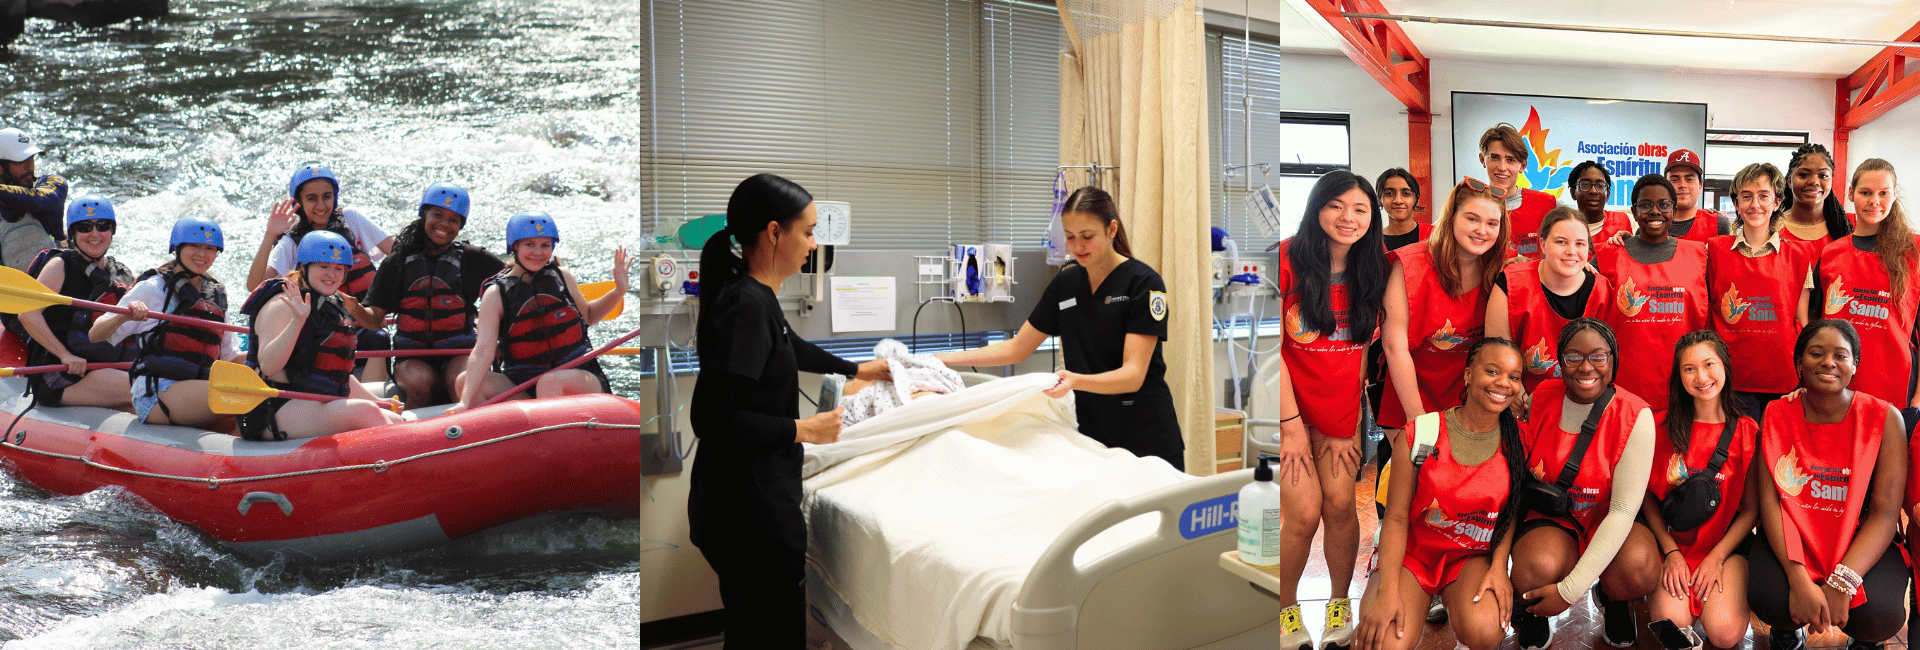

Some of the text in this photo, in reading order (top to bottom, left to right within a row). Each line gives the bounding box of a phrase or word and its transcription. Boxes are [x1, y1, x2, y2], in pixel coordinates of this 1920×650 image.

[1577, 141, 1668, 158] Asociación obras
[1648, 299, 1684, 314] Santo
[1849, 300, 1889, 320] Santo
[1583, 486, 1600, 494] obras
[1811, 480, 1848, 502] Sant
[1191, 501, 1239, 532] Hill-R
